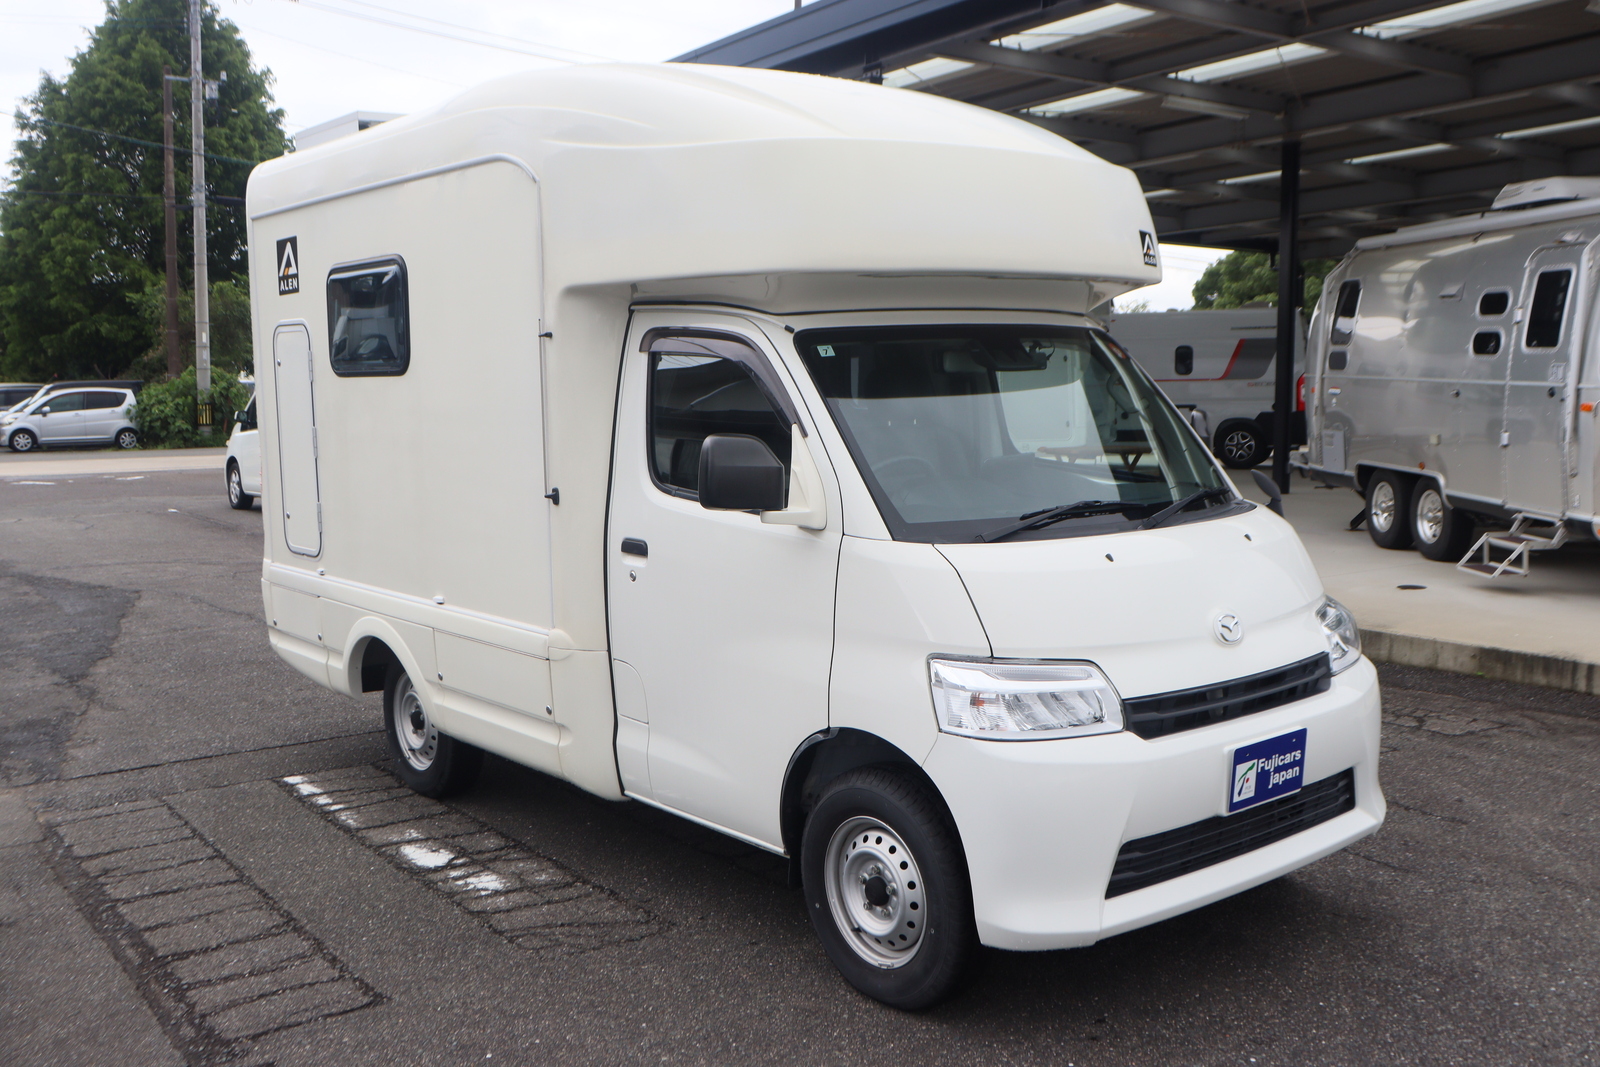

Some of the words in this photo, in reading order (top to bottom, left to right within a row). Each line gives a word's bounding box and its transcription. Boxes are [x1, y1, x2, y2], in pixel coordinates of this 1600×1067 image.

[280, 277, 298, 291] ALEN
[1257, 749, 1302, 773] Fujicars
[1267, 766, 1300, 789] japan
